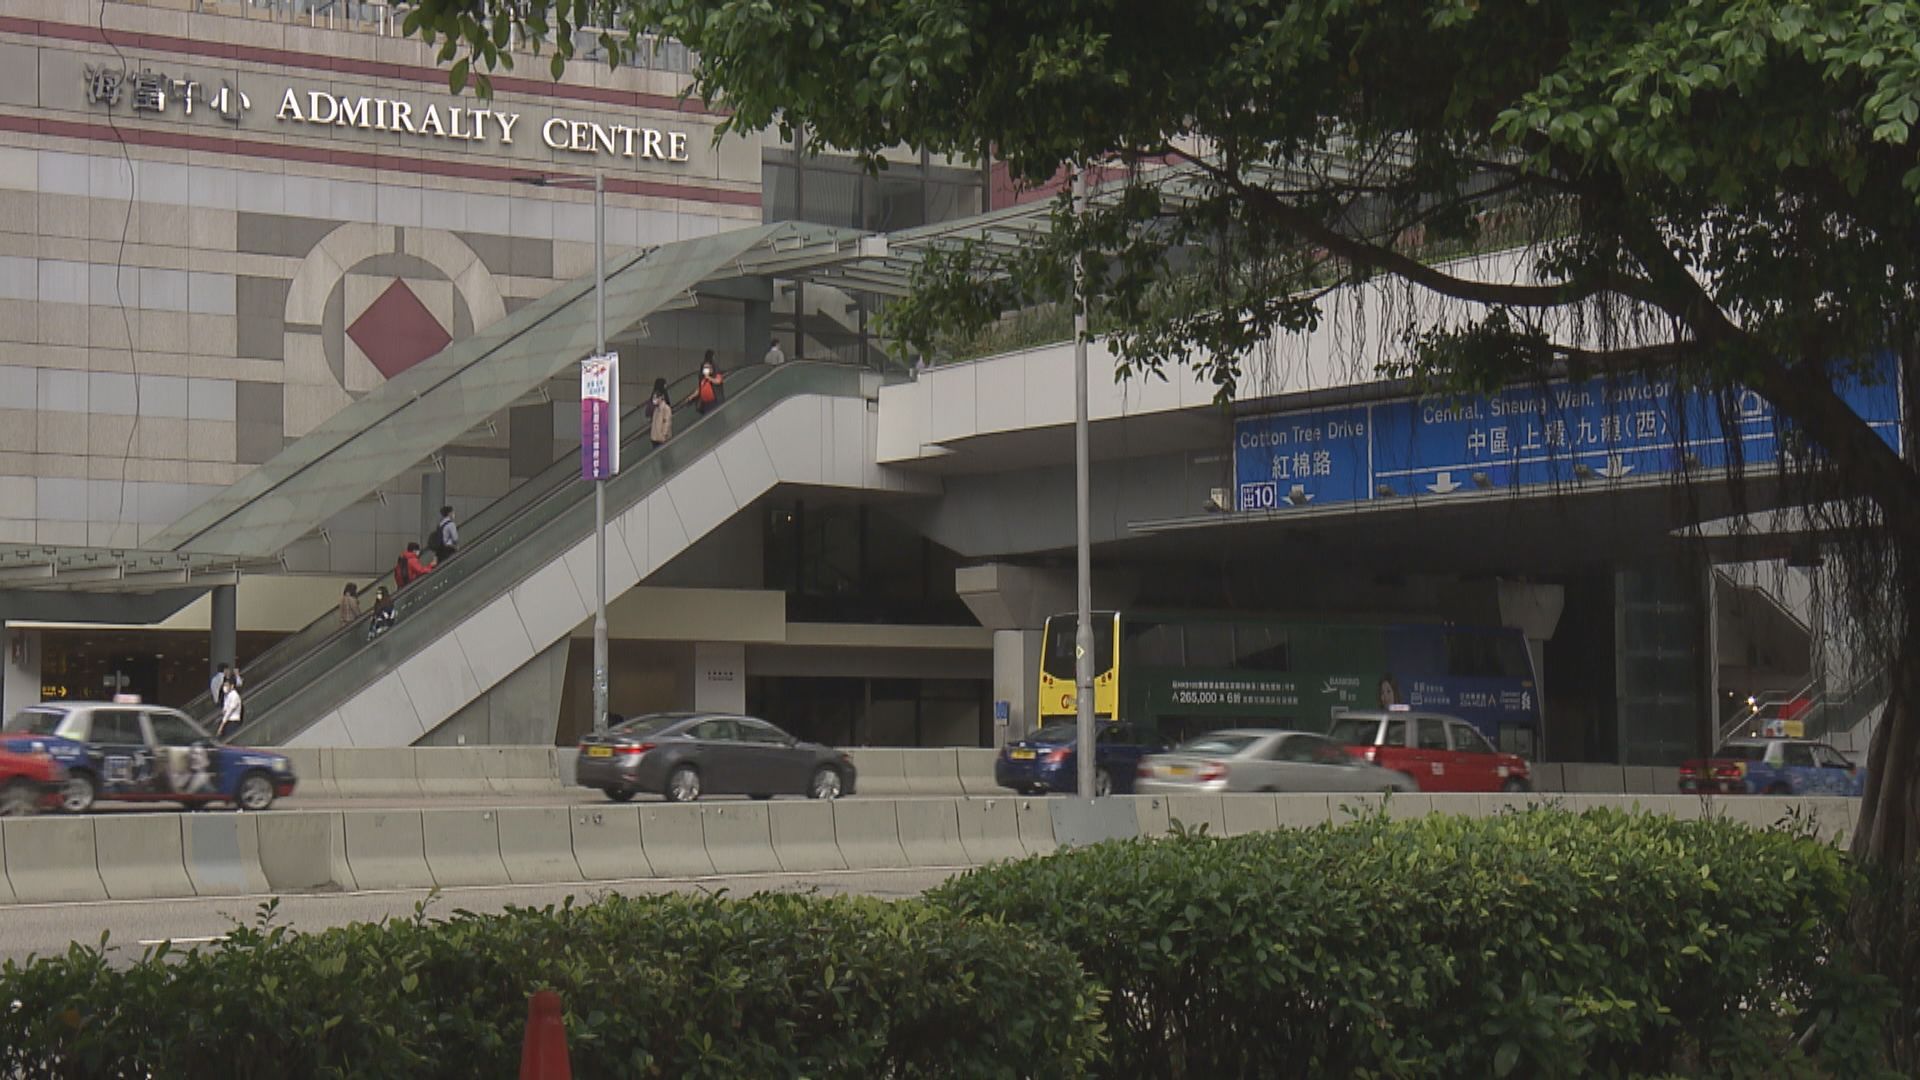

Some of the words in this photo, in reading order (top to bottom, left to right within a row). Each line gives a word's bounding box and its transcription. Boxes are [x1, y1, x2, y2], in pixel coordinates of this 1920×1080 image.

[275, 87, 520, 144] ADMIRALTY
[542, 118, 690, 163] CENTRE
[1240, 431, 1287, 449] Cotton
[1292, 424, 1321, 444] Tree
[1328, 419, 1364, 440] Drive
[1271, 448, 1332, 480] 紅棉路
[1255, 486, 1273, 507] 10
[1179, 691, 1217, 704] 265,000
